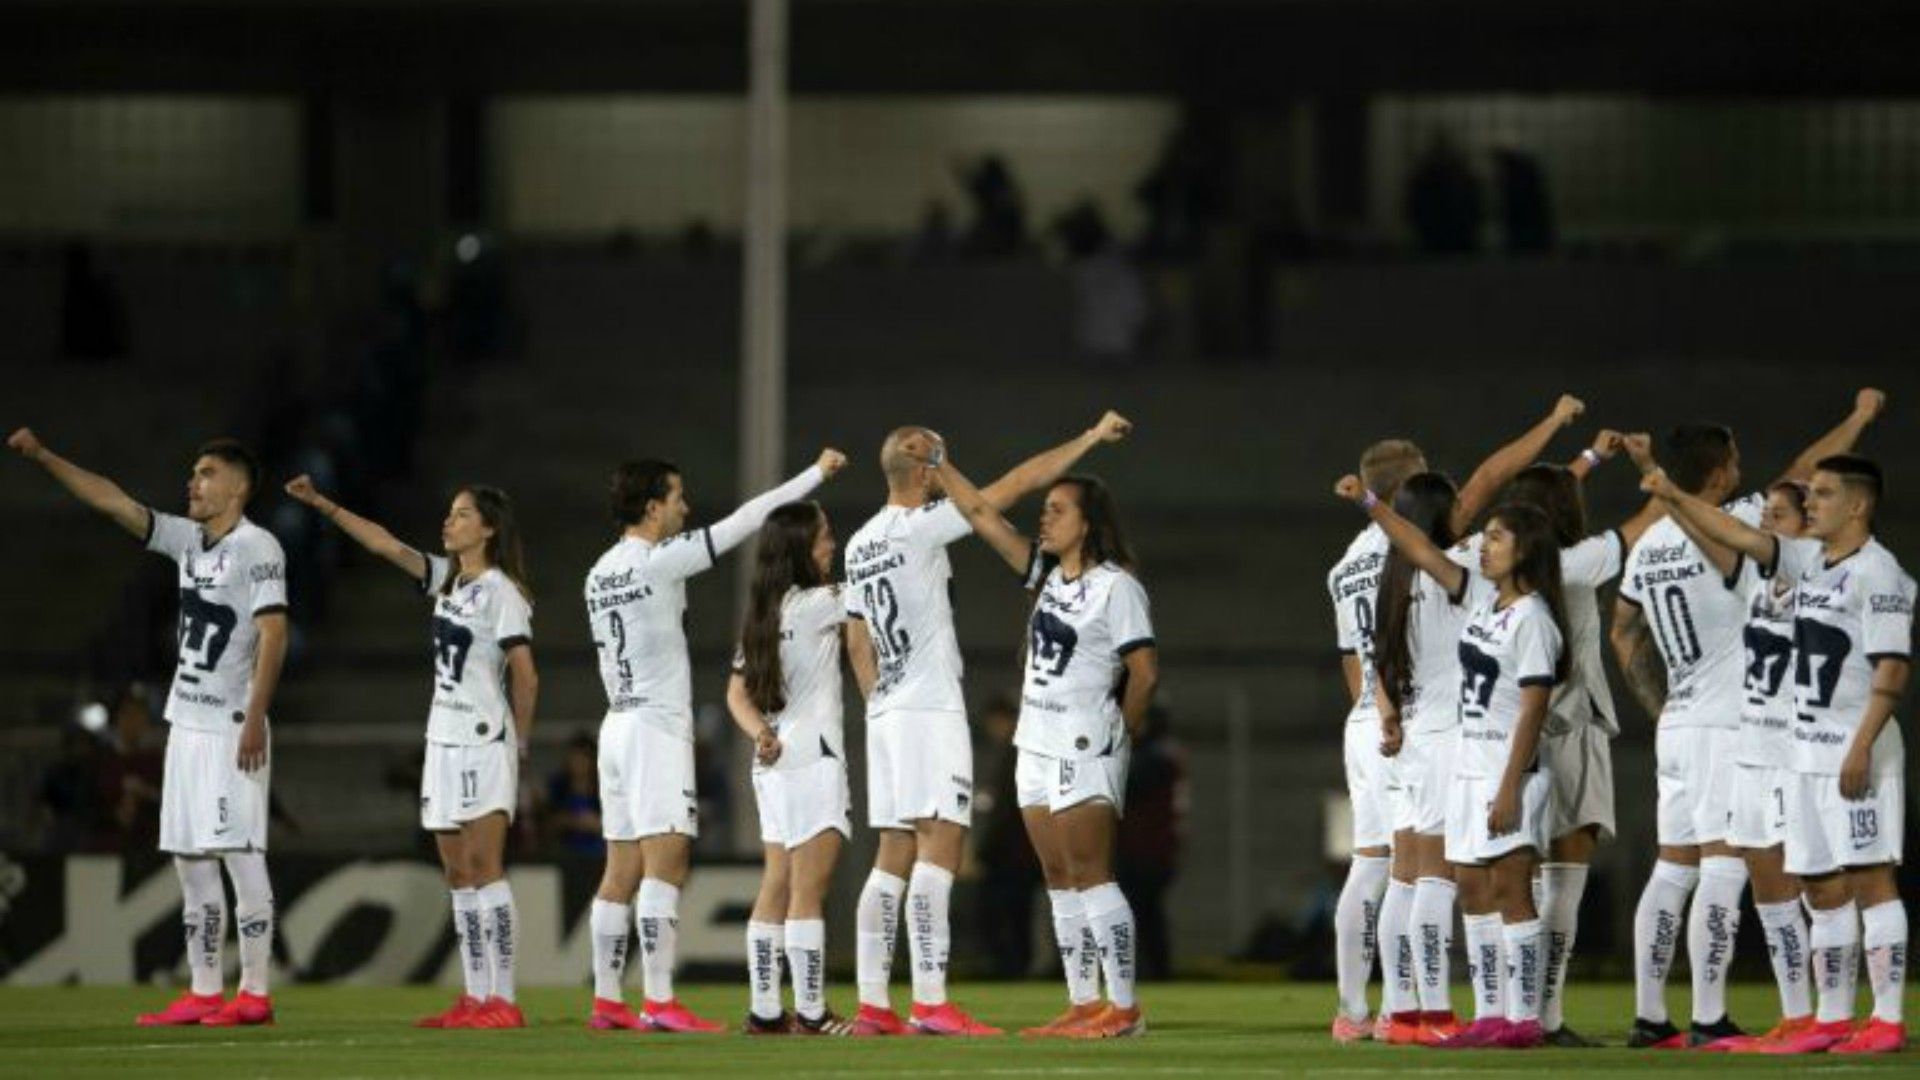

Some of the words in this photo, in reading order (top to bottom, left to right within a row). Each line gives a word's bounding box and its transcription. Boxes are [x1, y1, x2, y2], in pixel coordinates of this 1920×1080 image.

[1645, 561, 1704, 585] SUZUKI
[1649, 585, 1703, 668] 10
[1848, 809, 1878, 838] 193
